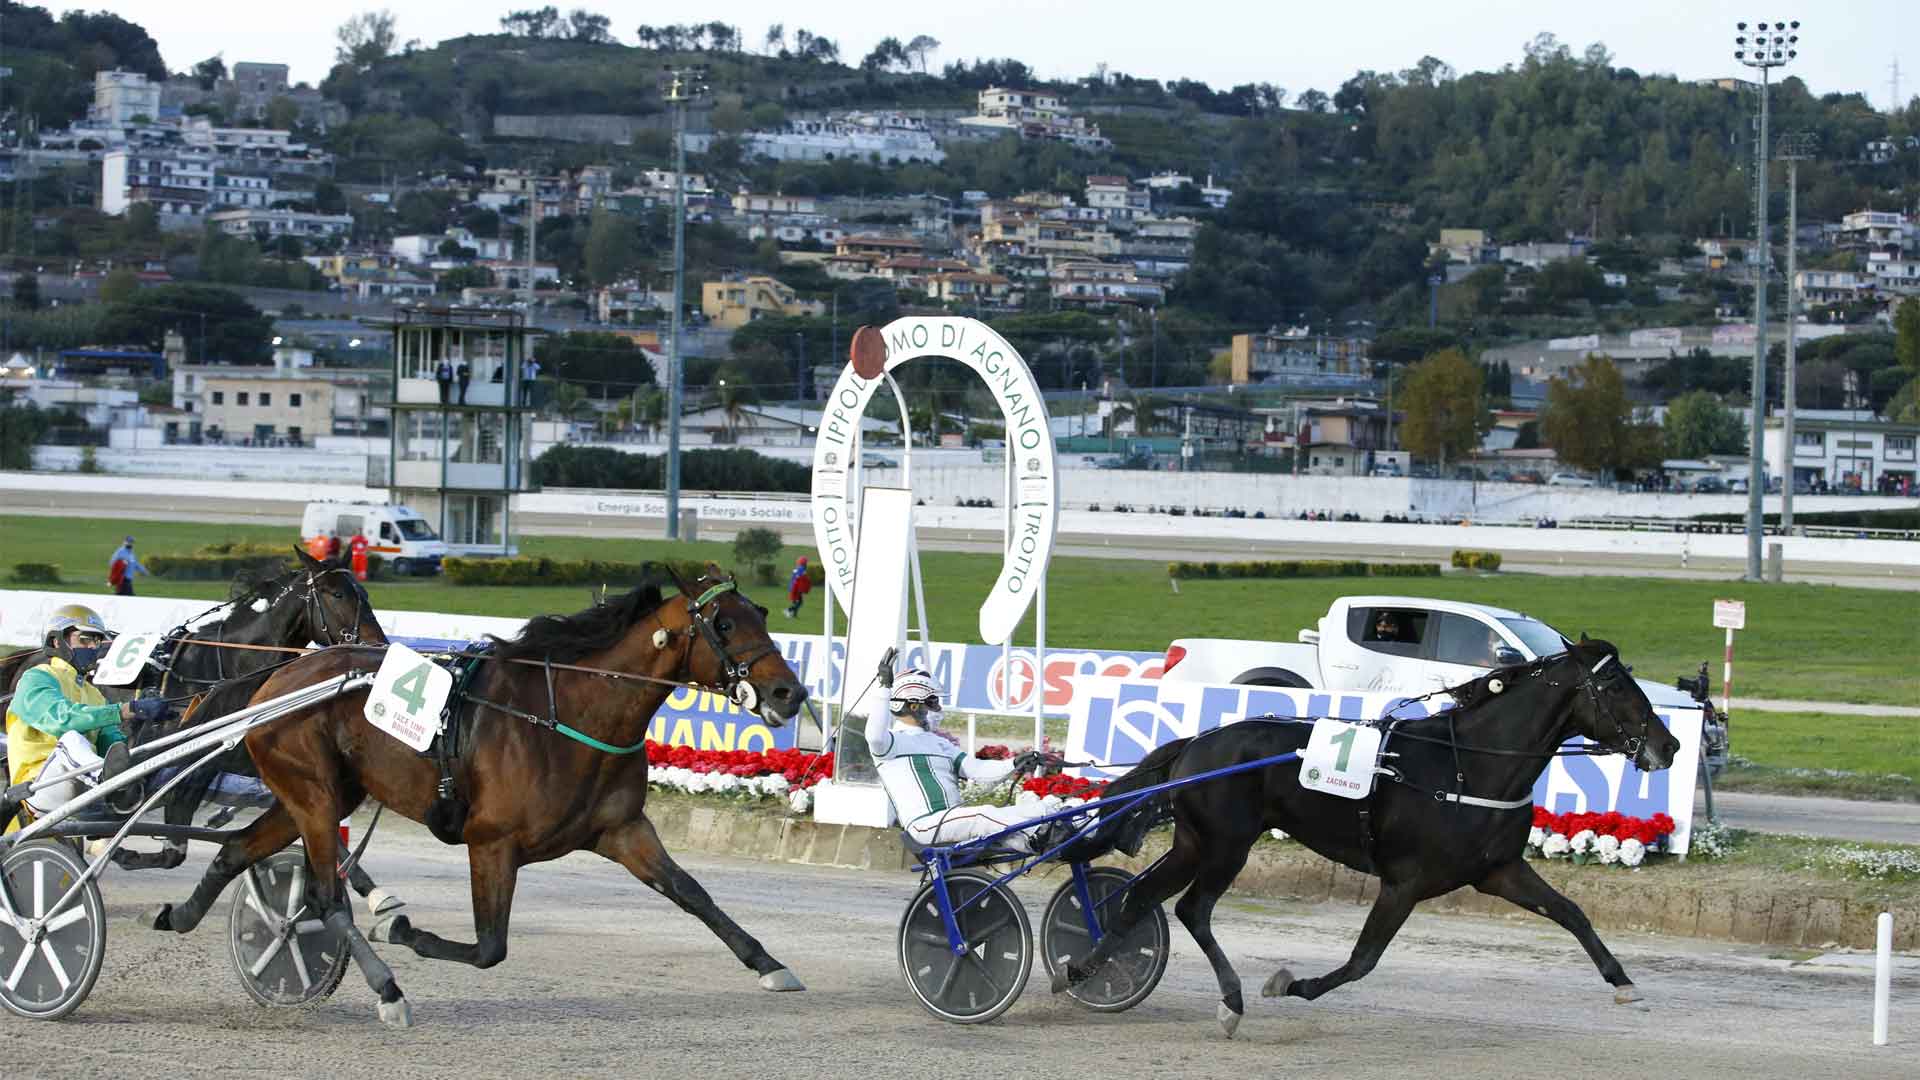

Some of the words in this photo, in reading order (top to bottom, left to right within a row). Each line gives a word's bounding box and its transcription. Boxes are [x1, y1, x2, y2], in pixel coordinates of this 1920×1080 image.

[942, 324, 965, 350] DI
[970, 341, 1040, 449] AGNANO
[598, 502, 641, 514] Energia
[703, 505, 746, 517] Energia
[750, 507, 793, 518] Sociale
[823, 506, 853, 588] TROTTO
[1007, 512, 1042, 593] TROTTO
[116, 637, 146, 668] 6
[391, 662, 433, 716] 4
[1330, 727, 1357, 772] 1
